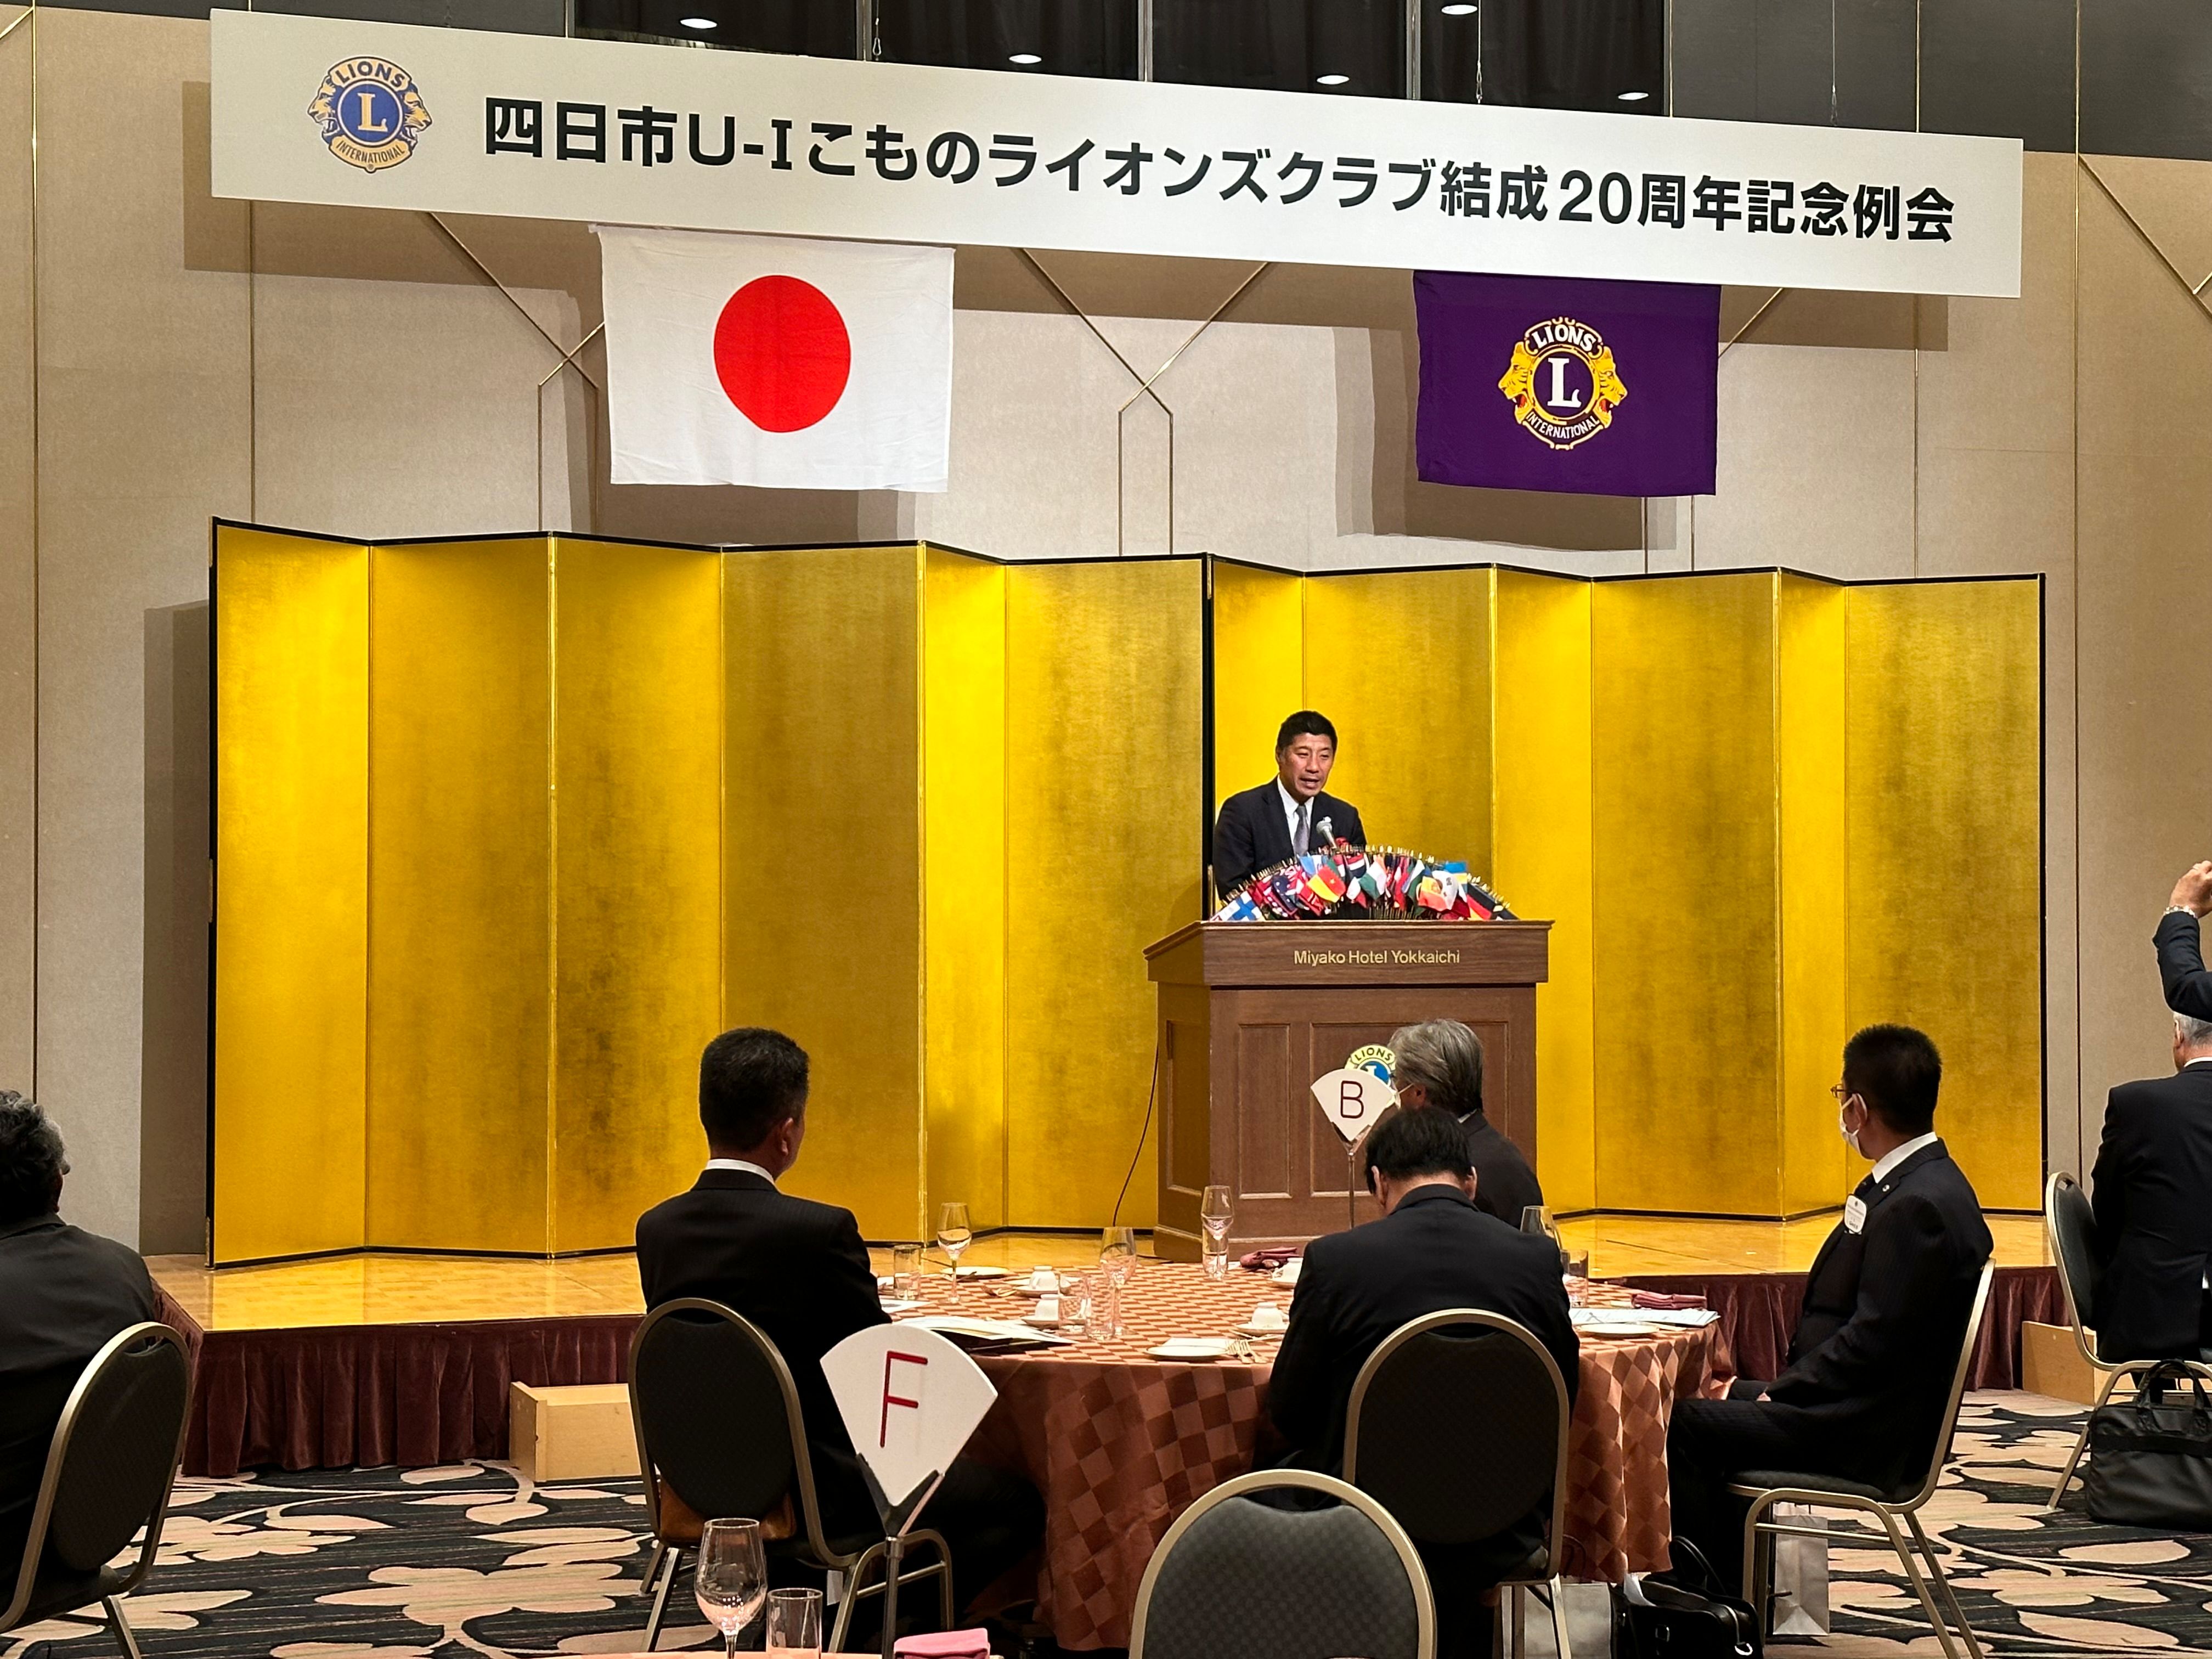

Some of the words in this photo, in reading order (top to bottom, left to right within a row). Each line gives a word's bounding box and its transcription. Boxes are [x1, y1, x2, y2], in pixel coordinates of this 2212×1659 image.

[335, 61, 405, 87] LIONS
[357, 93, 388, 132] L
[336, 140, 405, 163] INTERNATIONAL
[486, 97, 1954, 243] 四日市U-Iこものライオンズクラブ結成20周年記念例会
[1531, 324, 1596, 352] LIONS
[1547, 358, 1582, 408] L
[1526, 411, 1600, 439] INTERNATIONAL
[1294, 950, 1345, 967] Miyako
[1348, 950, 1387, 964] Hotel
[1391, 950, 1460, 964] Yokkaichi
[1355, 1047, 1393, 1062] LIONS
[1340, 1080, 1364, 1119] B
[879, 1350, 929, 1448] F
